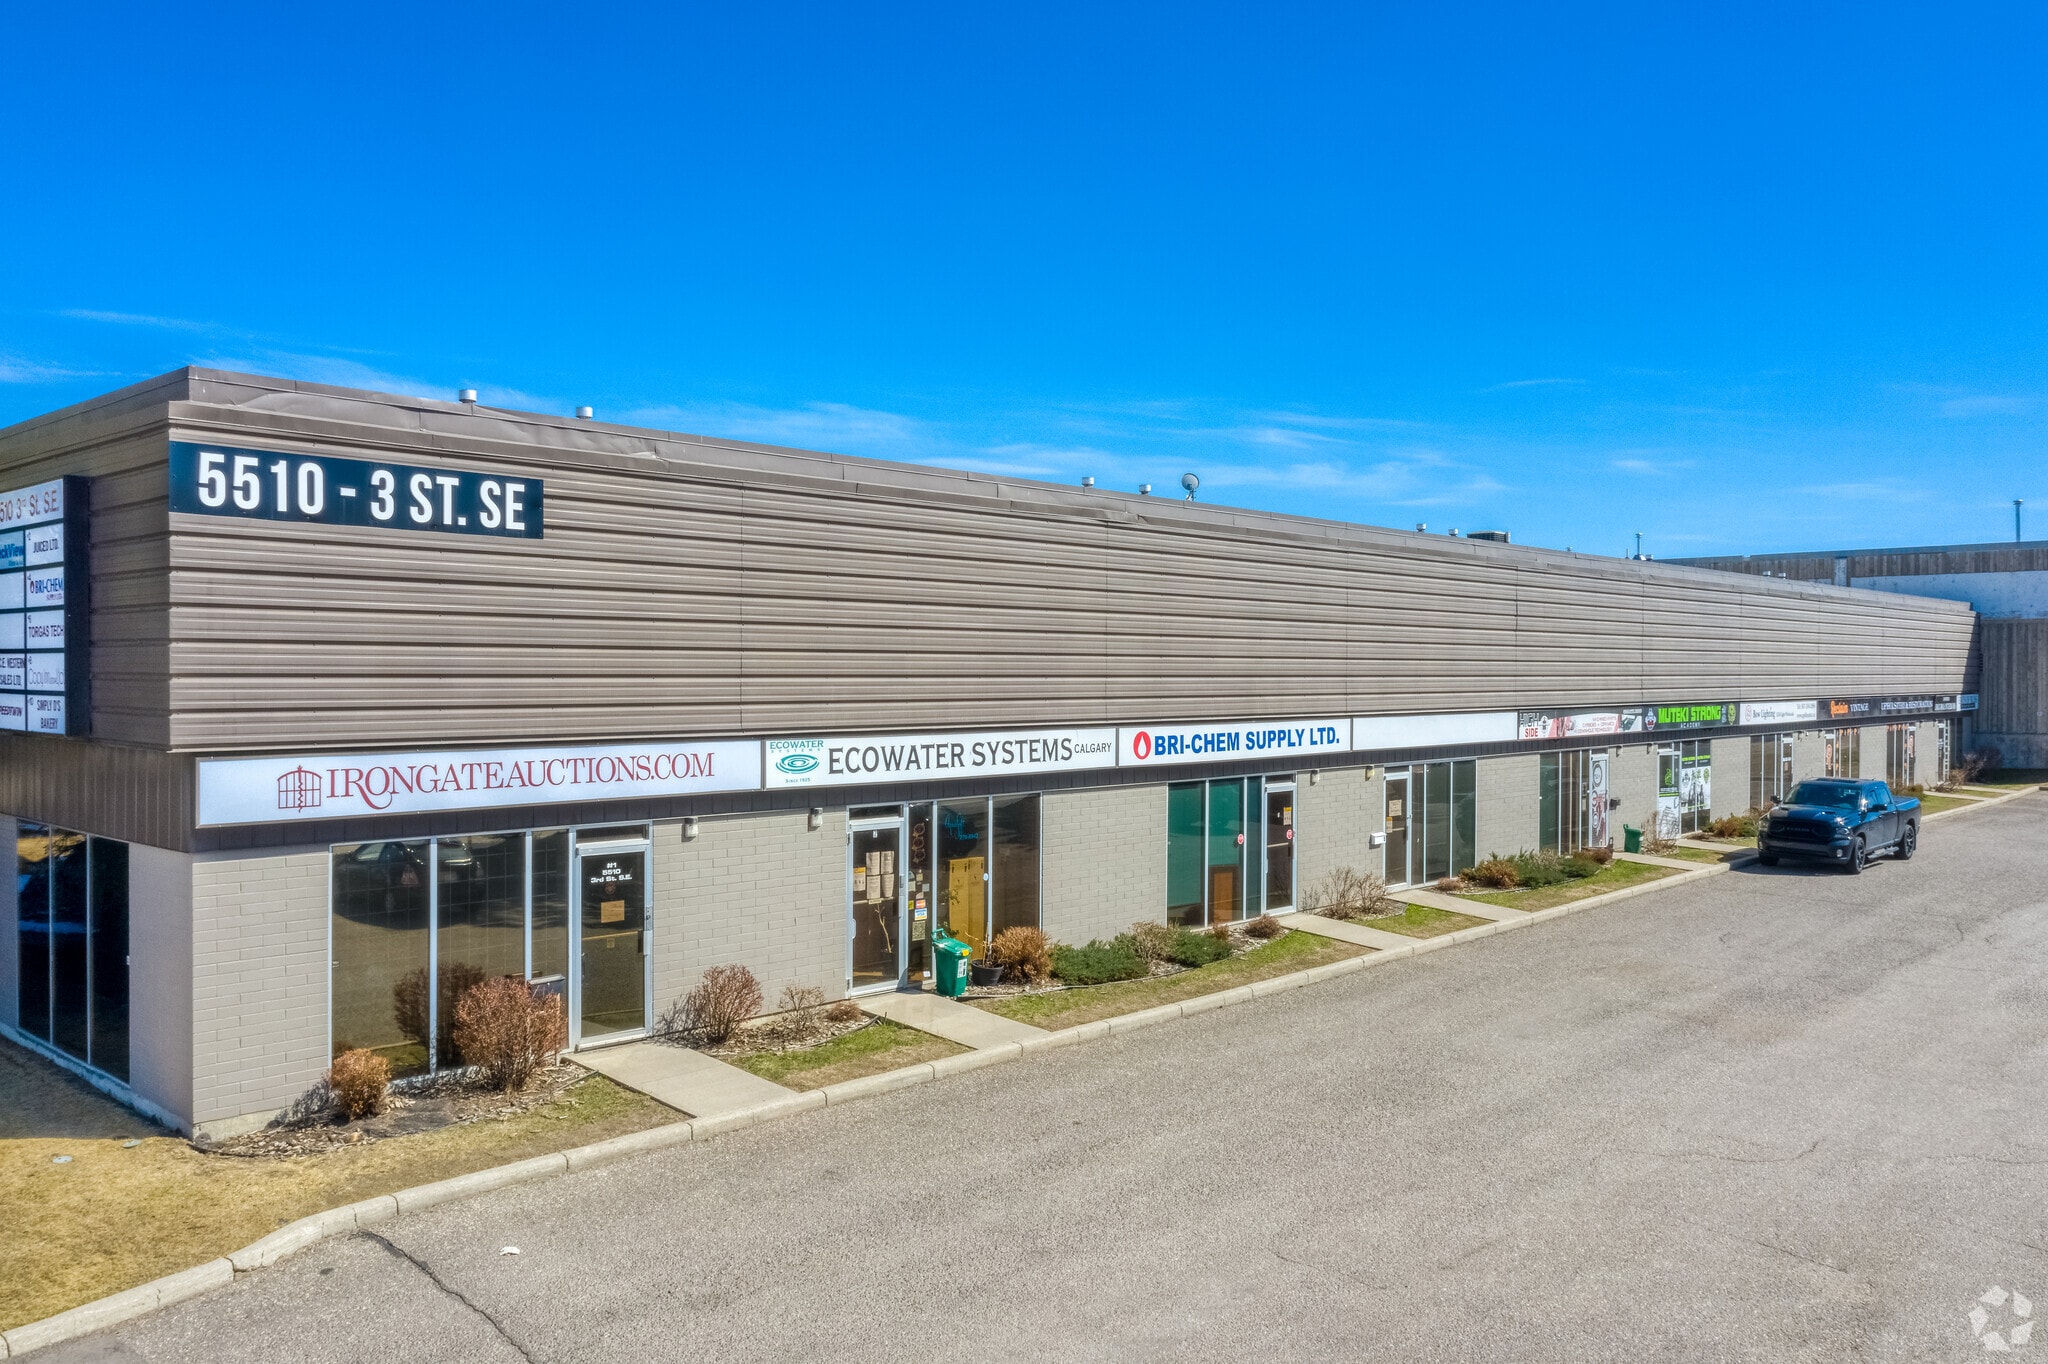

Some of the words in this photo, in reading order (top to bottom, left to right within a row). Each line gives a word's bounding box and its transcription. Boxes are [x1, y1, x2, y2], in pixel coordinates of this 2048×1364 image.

[197, 450, 326, 517] 5510
[369, 468, 396, 522] 3
[408, 475, 468, 527] ST.
[479, 484, 527, 532] SE
[1658, 707, 1689, 723] MUTEKI
[1690, 705, 1721, 721] STRONG
[769, 739, 824, 750] ECOWATER
[1154, 732, 1240, 756] BRI-CHEM
[1245, 728, 1306, 752] SUPPLY
[1309, 726, 1340, 746] LTD.
[1525, 728, 1538, 737] SIDE
[828, 742, 965, 775] ECOWATER
[970, 738, 1073, 767] SYSTEMS
[1073, 742, 1112, 755] CALGARY
[325, 752, 715, 811] IRONGATEAUCTIONS.COM
